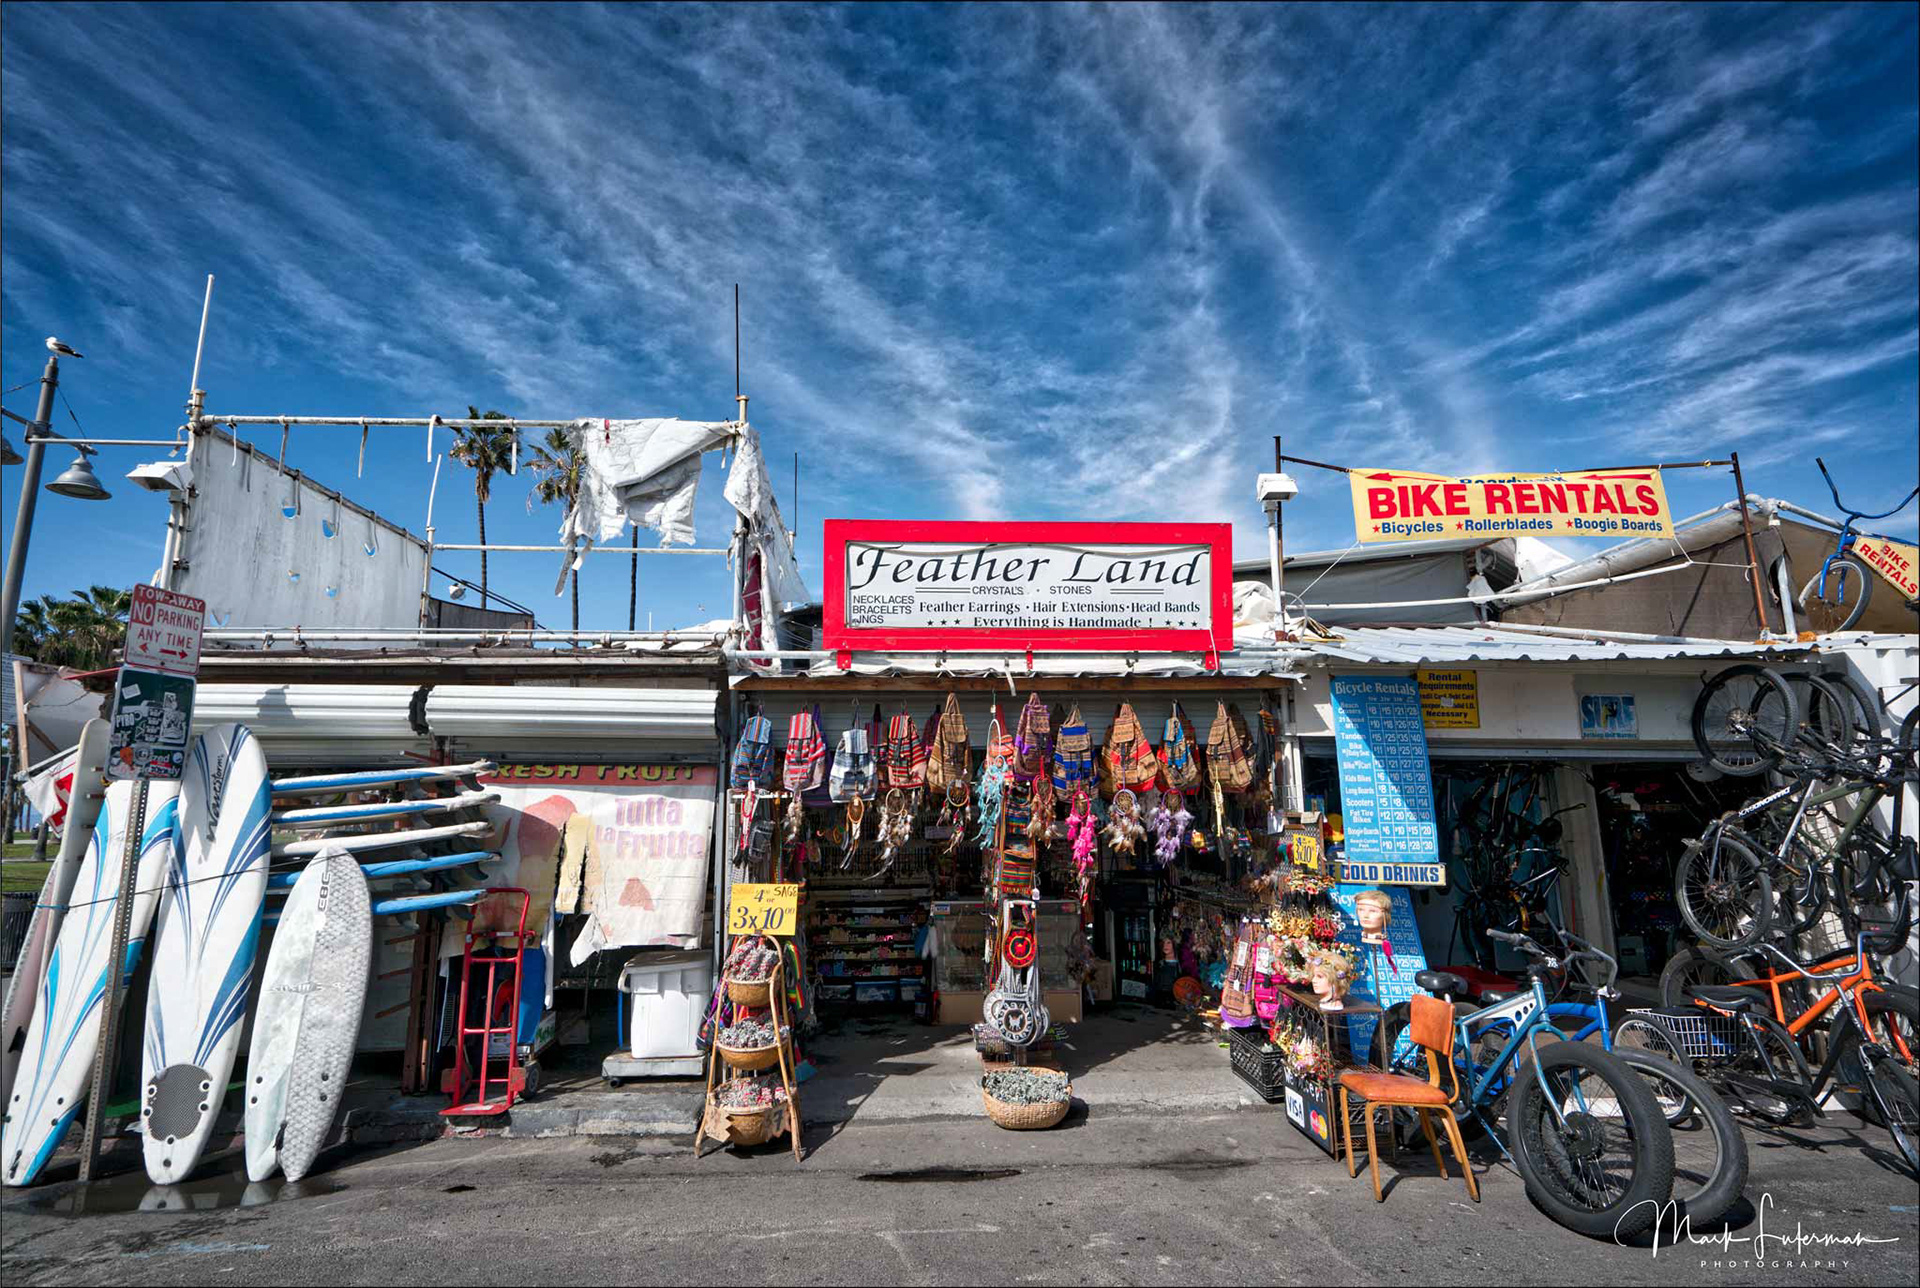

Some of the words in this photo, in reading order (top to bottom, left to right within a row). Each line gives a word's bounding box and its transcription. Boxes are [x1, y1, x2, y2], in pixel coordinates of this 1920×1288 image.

[1367, 484, 1470, 520] BIKE
[1483, 483, 1659, 516] RENTALS
[1381, 521, 1444, 536] Bicycles
[1464, 518, 1553, 532] Rollerblades
[1574, 518, 1618, 532] Boogie
[1621, 518, 1663, 531] Boards
[850, 543, 1050, 590] Feather
[1062, 551, 1210, 586] Land
[1881, 545, 1910, 571] BIKE
[1859, 543, 1918, 594] RENTALS
[138, 586, 203, 611] TOW-AWAY
[1049, 586, 1092, 595] STONES
[853, 595, 915, 605] NECKLACES
[919, 602, 965, 613] Feather
[968, 602, 1020, 615] Earrings
[1032, 602, 1057, 613] Hair
[1061, 602, 1125, 613] Extensions
[1131, 602, 1161, 613] Head
[1164, 602, 1200, 613] Bands
[134, 600, 154, 623] NO
[157, 609, 200, 631] PARKING
[853, 605, 912, 614] BRACELETS
[974, 617, 1050, 628] Everything
[1053, 617, 1065, 627] is
[1069, 617, 1142, 628] Handmade
[137, 627, 161, 643] ANY
[167, 633, 193, 649] TIME
[1429, 673, 1462, 681] Rental
[1335, 681, 1372, 696] Bicycle
[1375, 682, 1416, 696] Rentals
[1426, 711, 1468, 720] Necessary
[490, 765, 580, 780] RESH
[597, 765, 696, 781] FRUIT
[206, 755, 224, 841] Wavestorm
[1346, 799, 1374, 807] Scooters
[1380, 798, 1388, 807] $5
[1393, 798, 1401, 807] $8
[1407, 798, 1415, 807] $11
[1418, 798, 1427, 807] $14
[614, 797, 684, 827] Tutta
[1382, 826, 1390, 835] $6
[1395, 826, 1405, 835] $10
[1408, 826, 1418, 835] $15
[1421, 826, 1431, 835] $20
[594, 824, 616, 844] La
[616, 830, 706, 861] Frutta
[1341, 864, 1378, 881] COLD
[1383, 865, 1439, 883] DRINKS
[774, 886, 798, 897] SAGE
[1287, 1096, 1303, 1119] VISA
